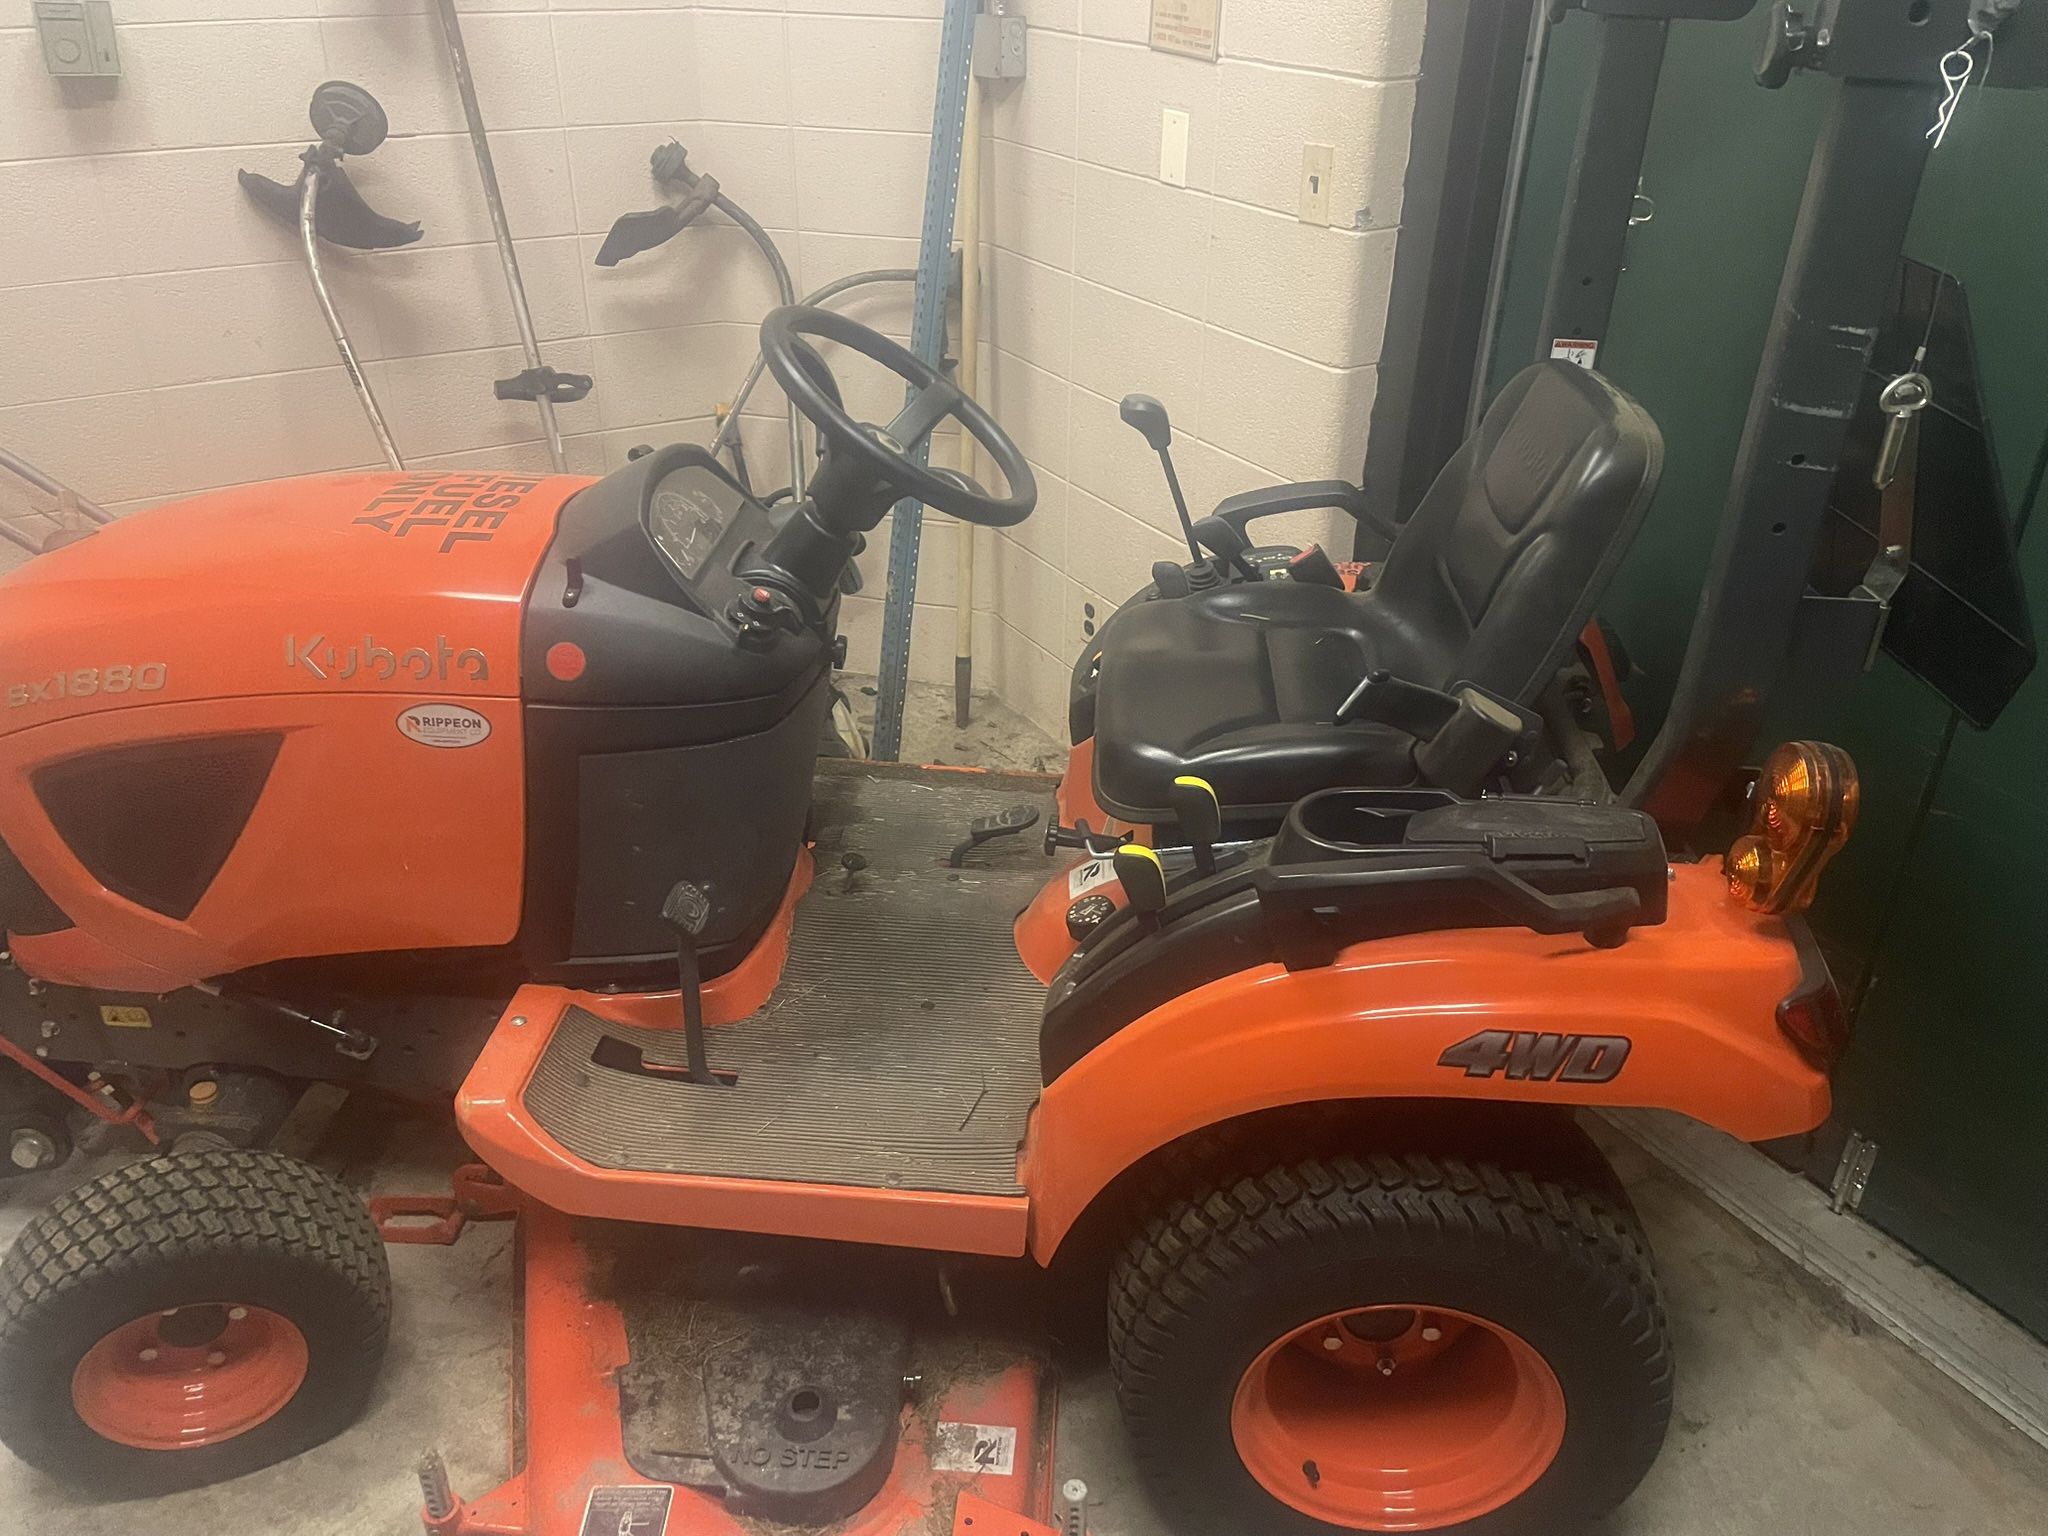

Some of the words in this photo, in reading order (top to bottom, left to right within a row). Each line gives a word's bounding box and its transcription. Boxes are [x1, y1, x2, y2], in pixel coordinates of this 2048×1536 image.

[352, 472, 454, 532] ONLY
[394, 474, 500, 537] FUEL
[438, 475, 546, 554] IESEL
[285, 634, 490, 681] Kubota
[7, 662, 168, 708] BX1880
[422, 716, 482, 729] RIPPEON
[1436, 1028, 1633, 1084] 4WD
[729, 1445, 772, 1467] NO
[779, 1447, 850, 1470] STEP
